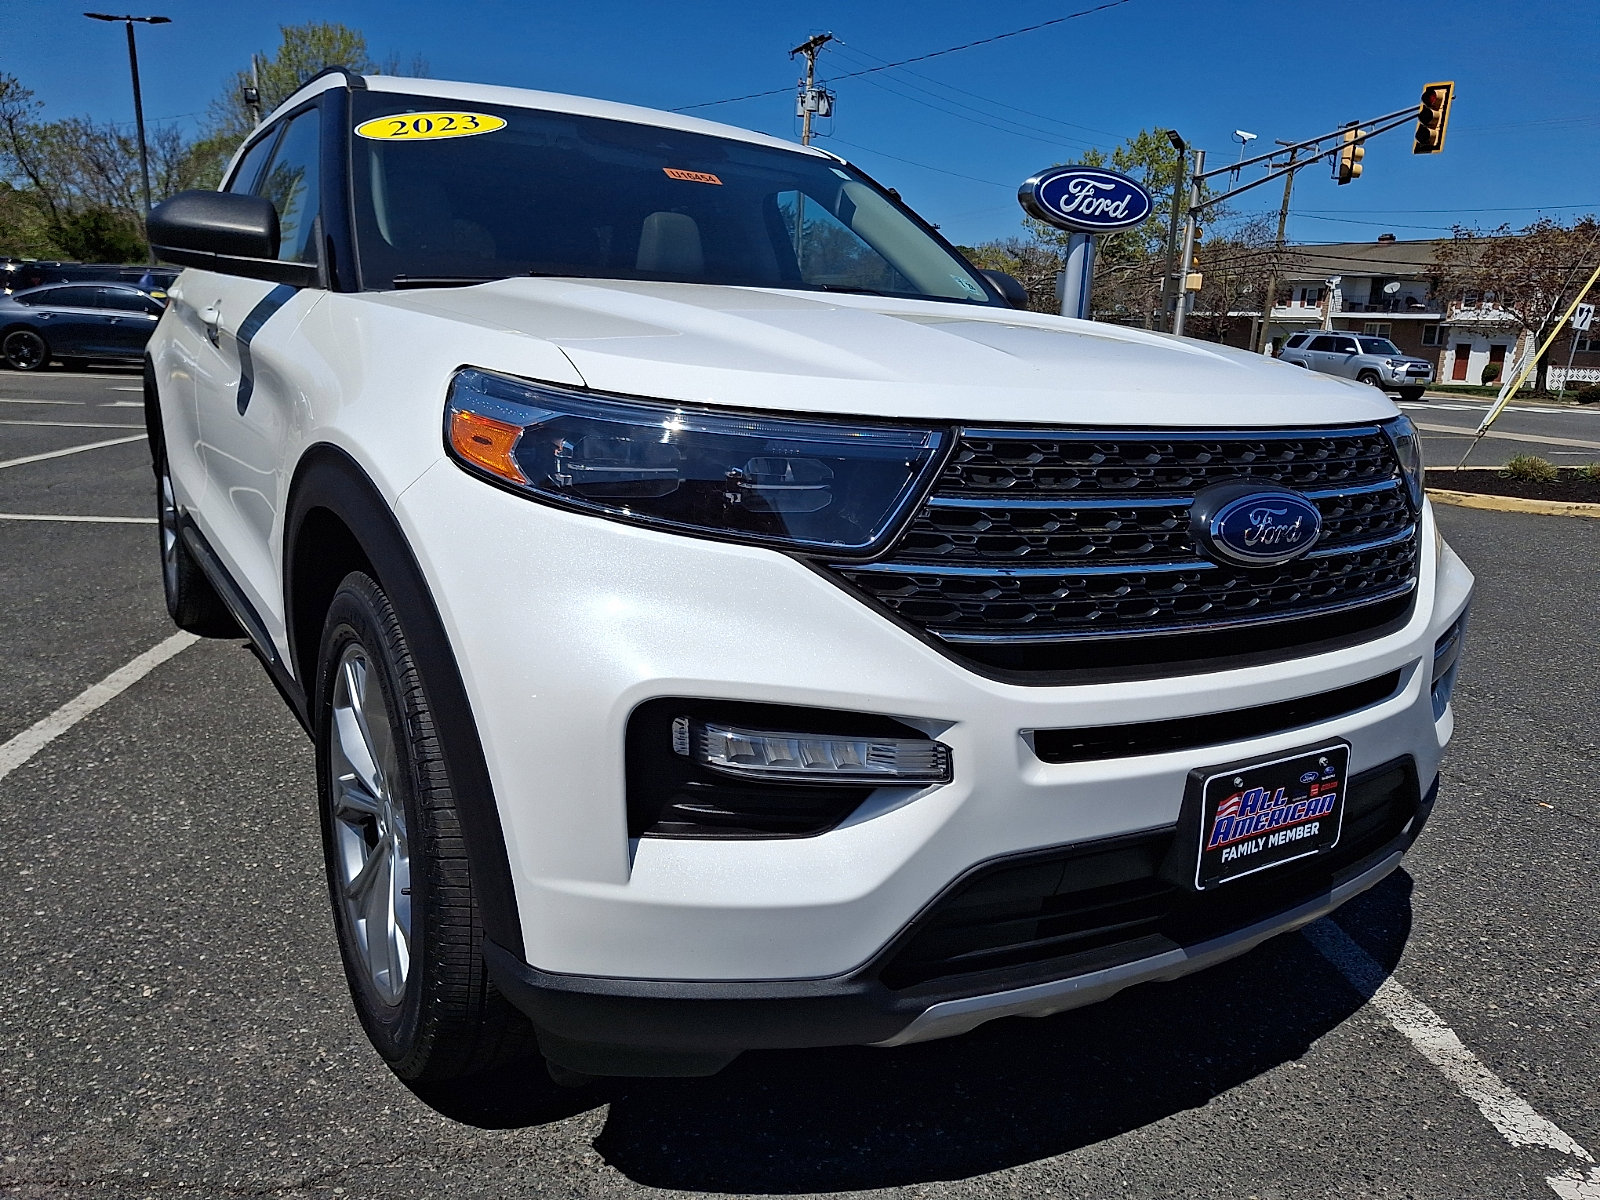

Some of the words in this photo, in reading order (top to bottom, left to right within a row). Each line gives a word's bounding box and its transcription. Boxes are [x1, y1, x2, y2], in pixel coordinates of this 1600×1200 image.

[388, 115, 480, 137] 2023
[669, 170, 716, 183] U16454
[1060, 178, 1132, 219] Ford
[1244, 507, 1303, 547] Ford
[1207, 793, 1336, 848] AMERICAN
[1238, 786, 1288, 817] ALL
[1221, 836, 1267, 863] FAMILY
[1268, 822, 1320, 848] MEMBER
